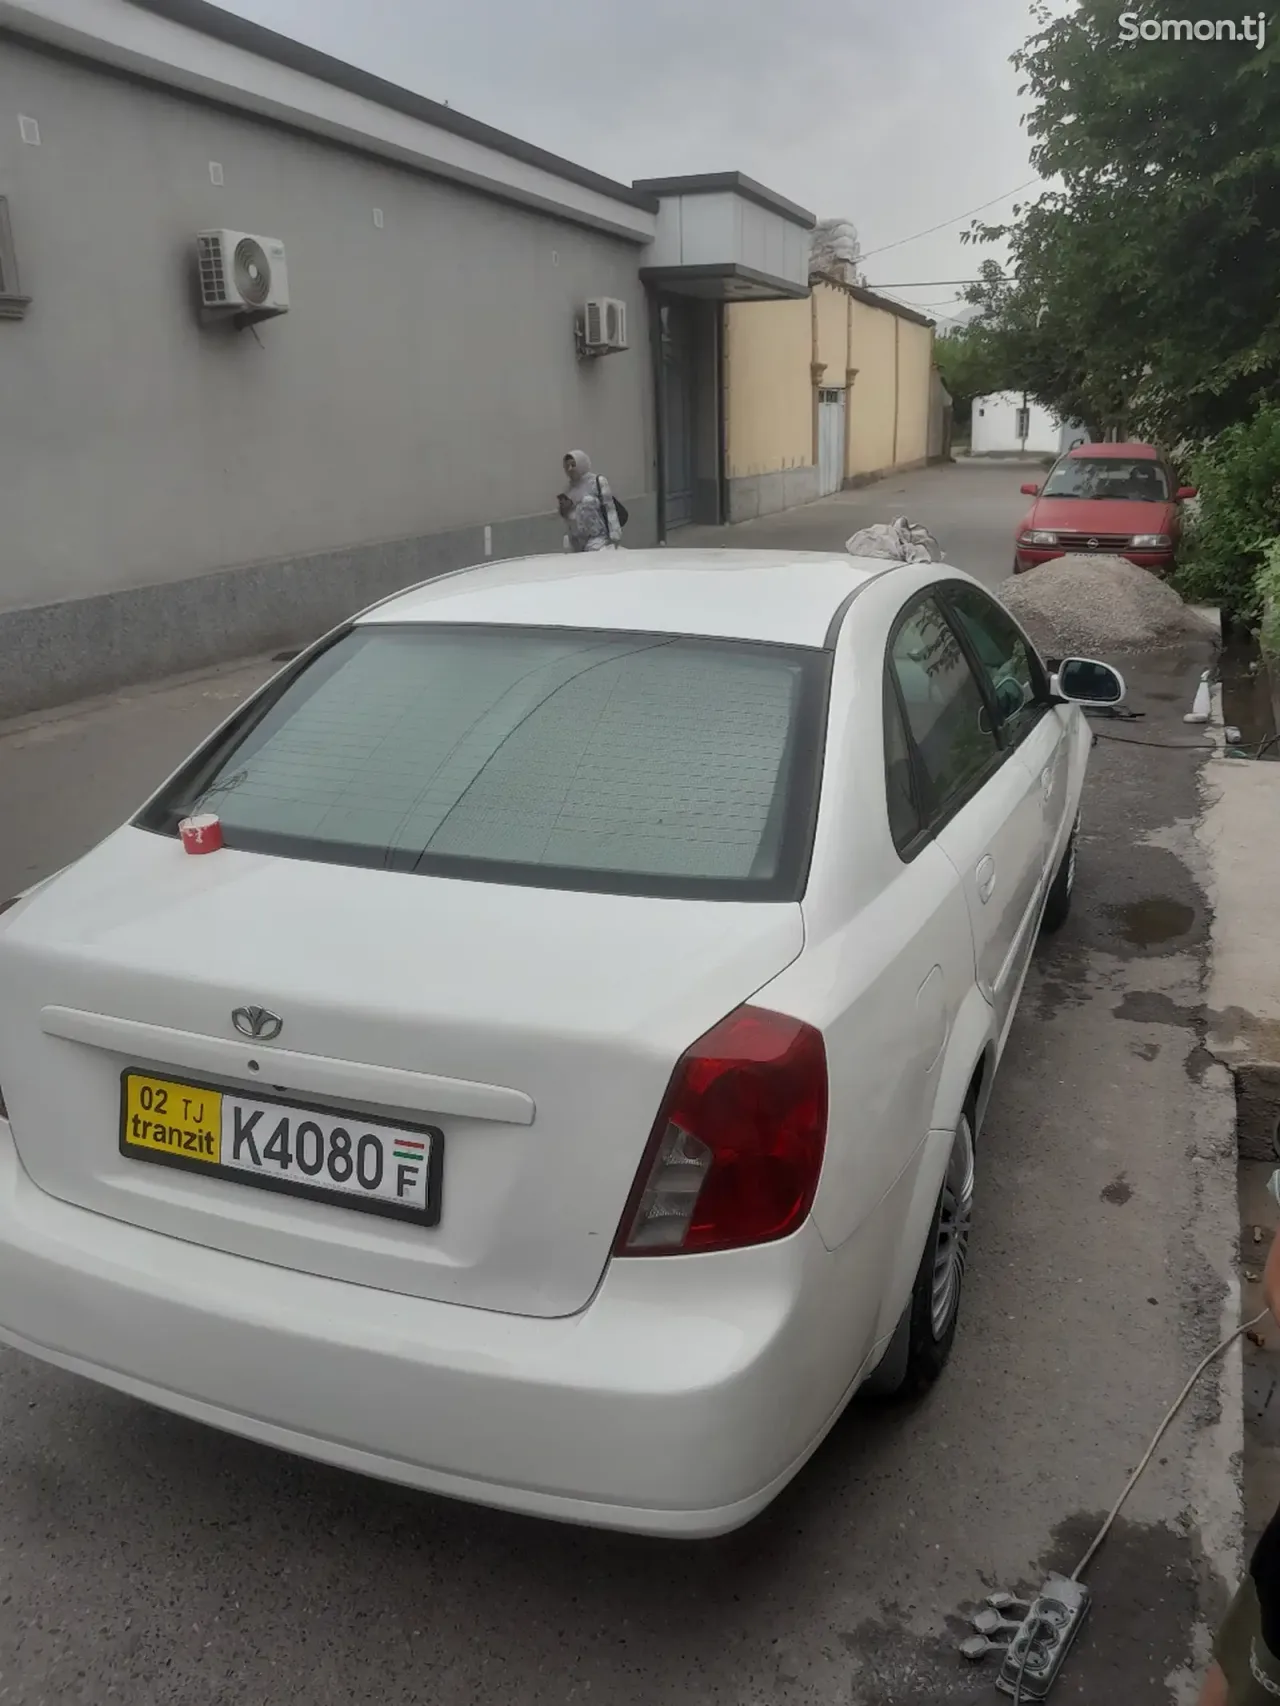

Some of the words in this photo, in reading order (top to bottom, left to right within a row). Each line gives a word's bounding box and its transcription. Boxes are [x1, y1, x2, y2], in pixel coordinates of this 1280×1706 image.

[140, 1086, 168, 1114] 02
[182, 1098, 204, 1124] TJ
[132, 1113, 214, 1155] tranzit
[233, 1106, 383, 1190] K4080
[397, 1164, 419, 1197] F
